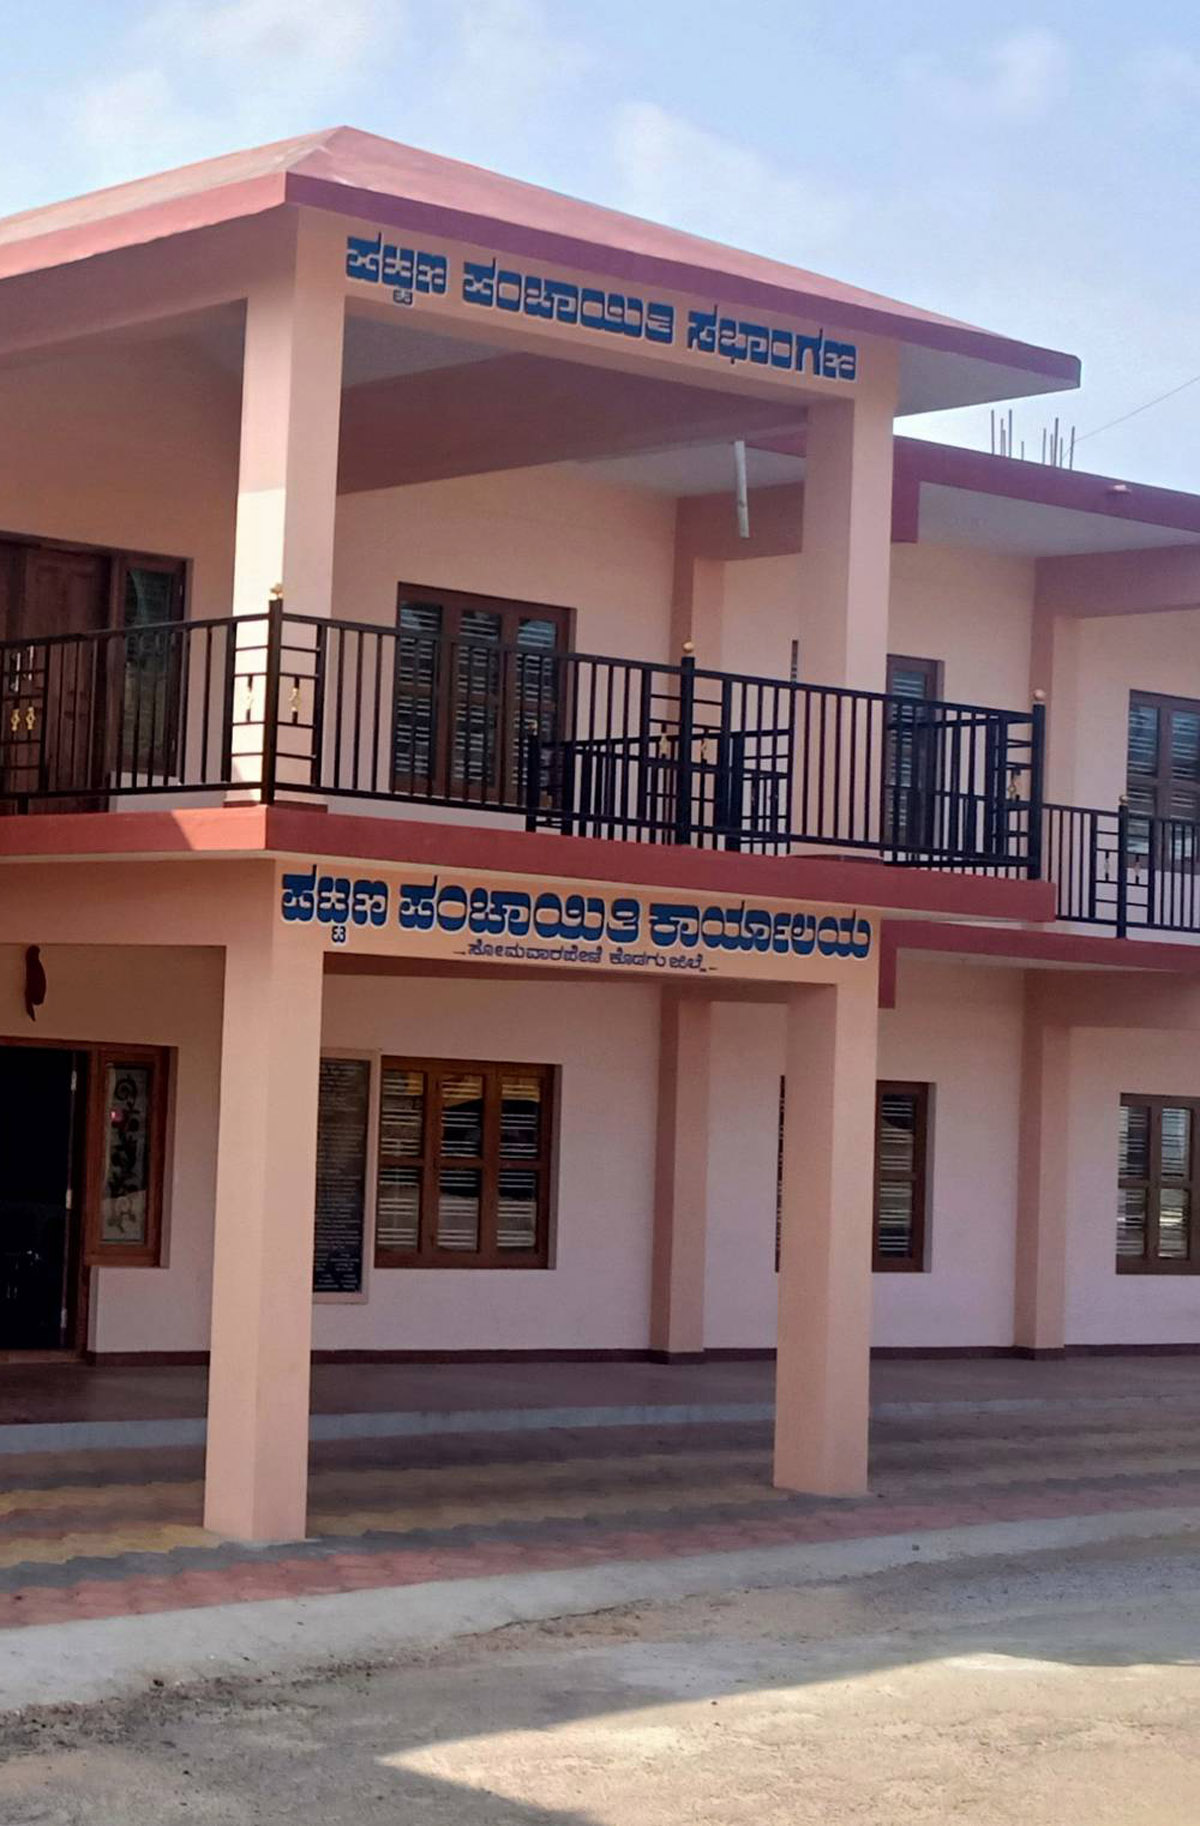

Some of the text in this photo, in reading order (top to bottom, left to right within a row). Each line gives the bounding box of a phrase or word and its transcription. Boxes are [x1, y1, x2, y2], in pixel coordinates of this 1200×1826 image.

[345, 231, 448, 306] ಪಟ್ಟಣ
[687, 304, 857, 381] ಸಭಾಂಗಣ
[281, 864, 873, 959] ಪಟ್ಟಣ ಪಂಚಾಯಿತಿ ಕಾರ್ಯಾಲಯ
[609, 946, 667, 968] ಕೊಡಗು
